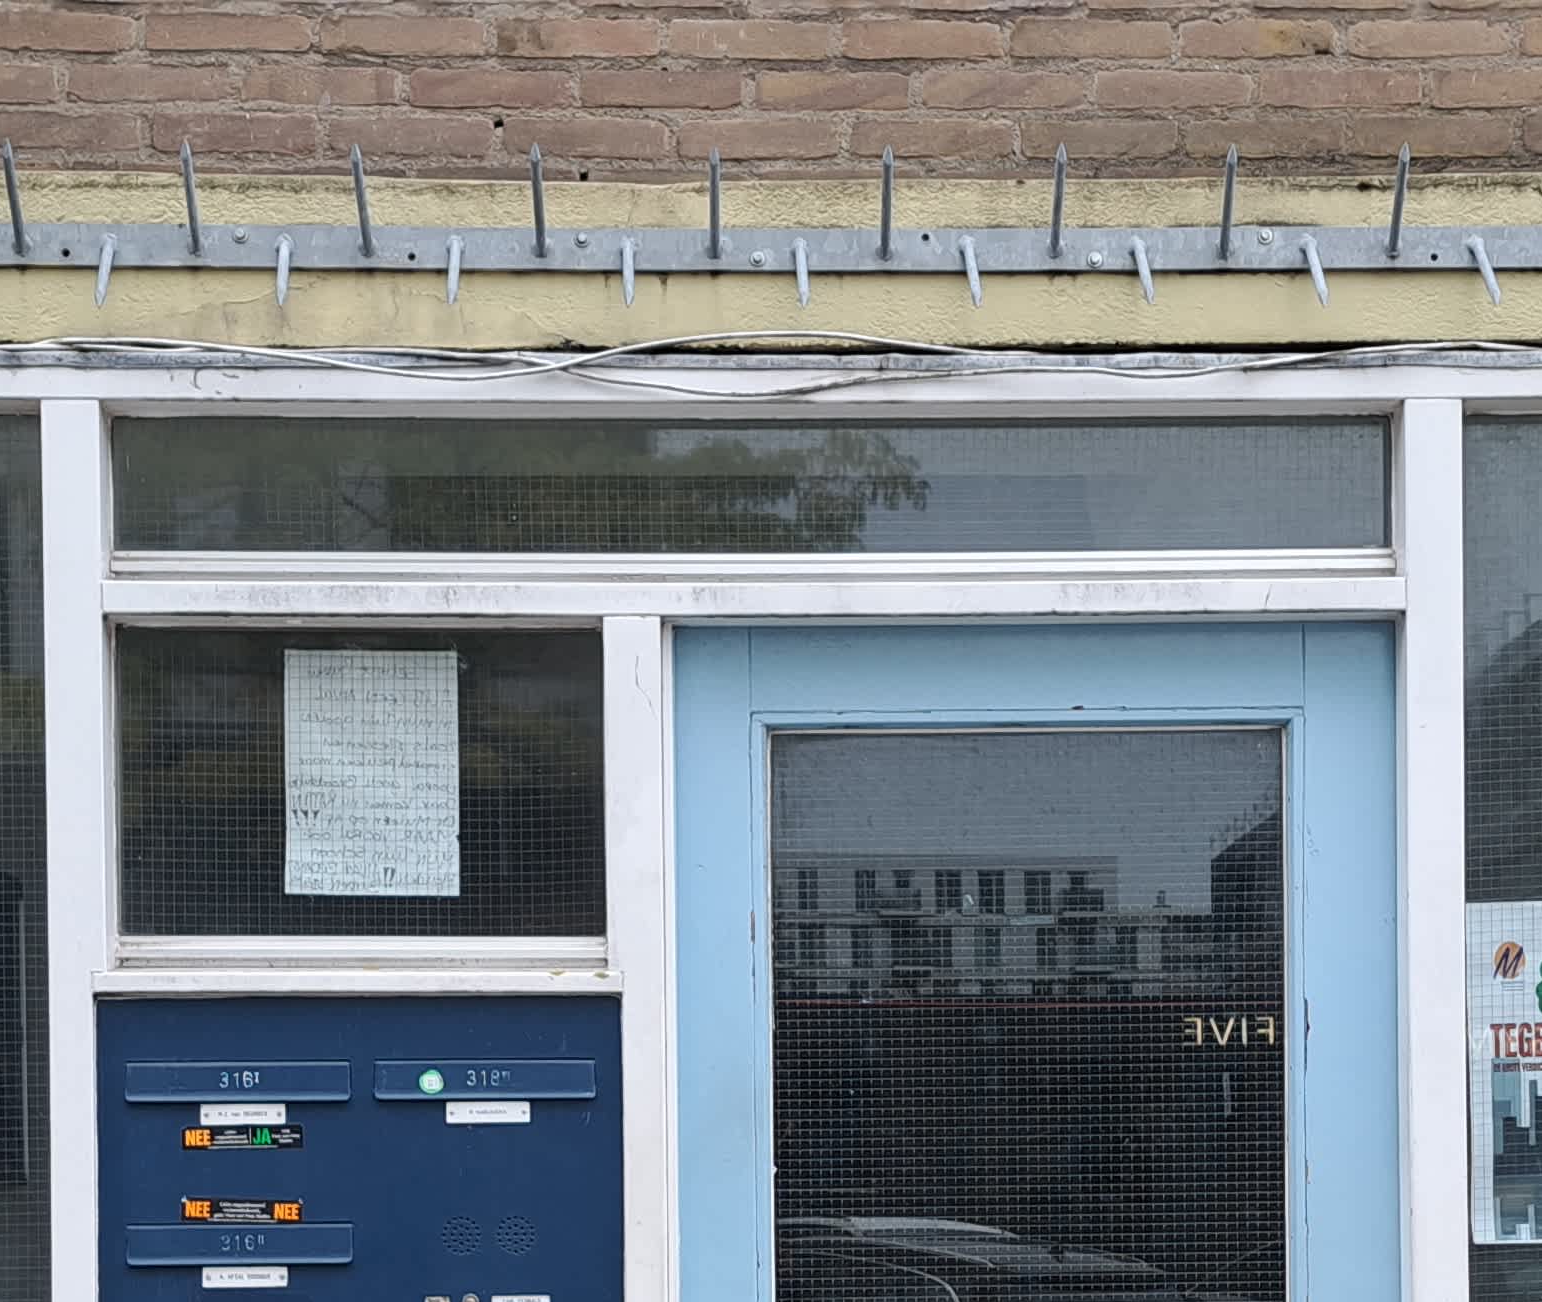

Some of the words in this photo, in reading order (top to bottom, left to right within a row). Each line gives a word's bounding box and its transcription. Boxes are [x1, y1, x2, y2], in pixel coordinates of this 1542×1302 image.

[185, 1130, 211, 1146] NEE
[253, 1128, 272, 1145] JA
[185, 1201, 211, 1218] NEE
[274, 1203, 300, 1220] NEE
